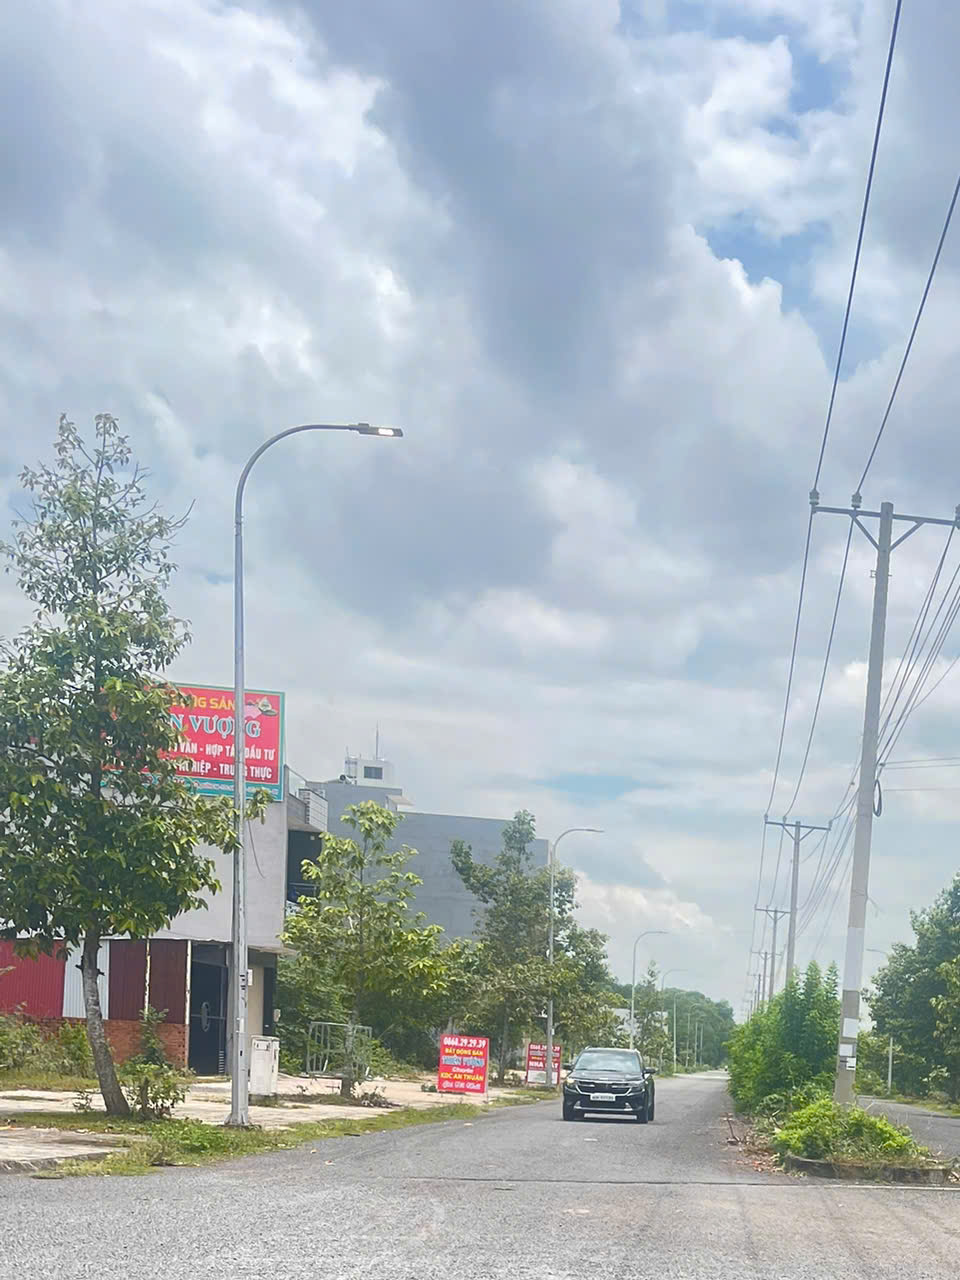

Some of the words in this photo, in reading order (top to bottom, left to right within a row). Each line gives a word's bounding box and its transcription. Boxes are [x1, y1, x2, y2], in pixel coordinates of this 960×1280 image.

[189, 714, 261, 739] VƯỢG
[206, 743, 223, 758] HỢP
[219, 763, 248, 777] TRUG
[250, 766, 272, 780] THỰC
